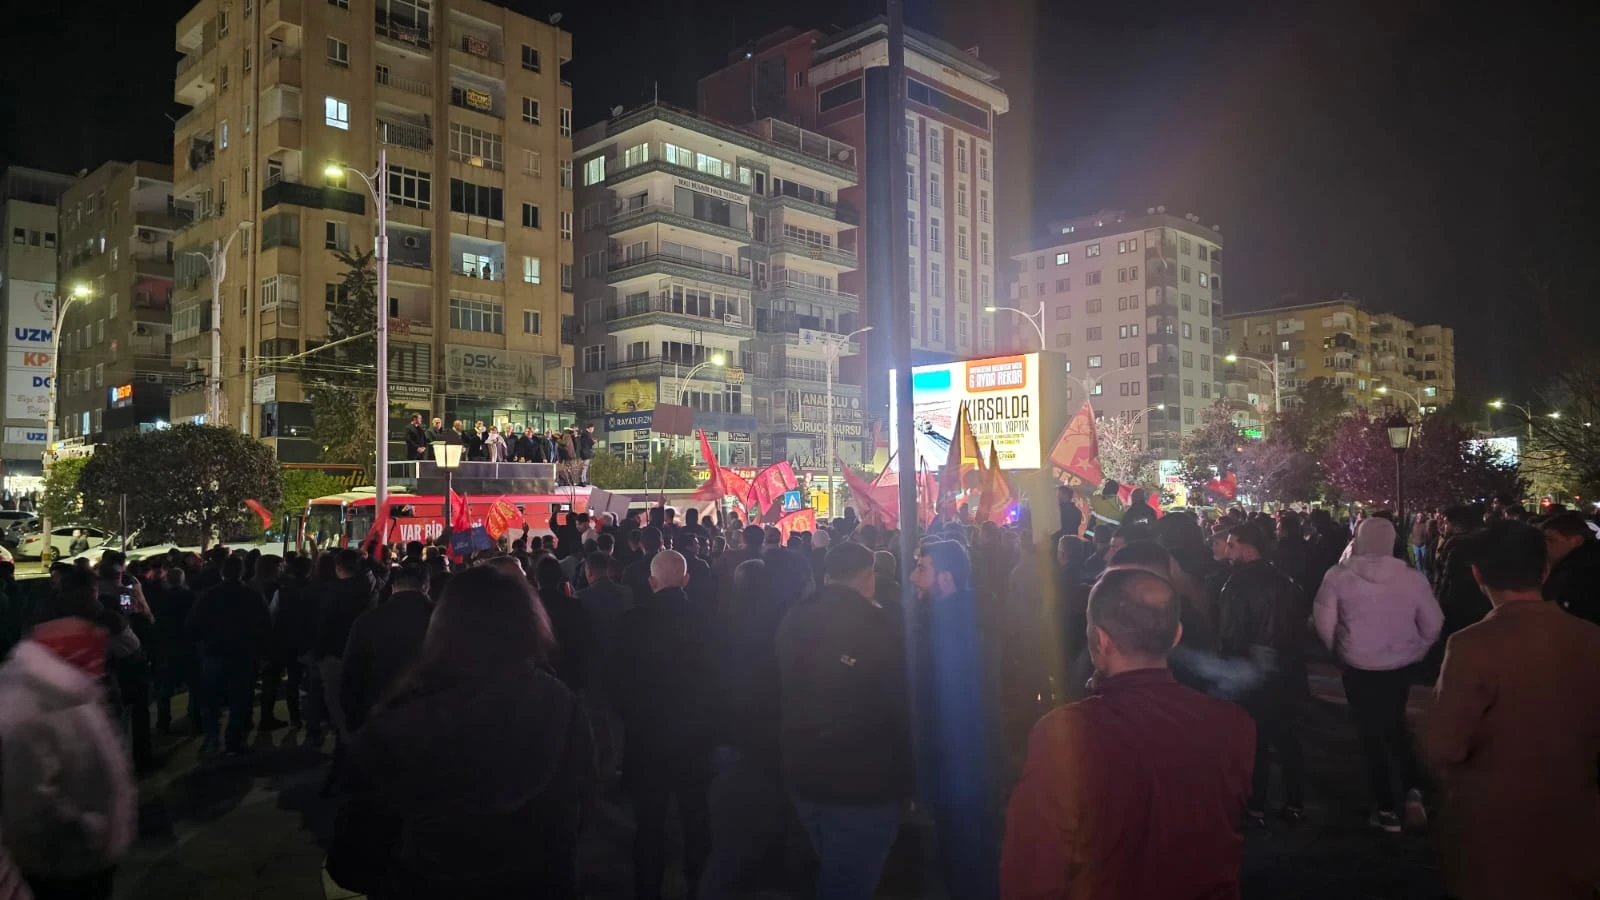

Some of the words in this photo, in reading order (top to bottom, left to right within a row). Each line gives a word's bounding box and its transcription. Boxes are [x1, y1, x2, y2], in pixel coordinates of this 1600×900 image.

[464, 354, 497, 369] DSK
[998, 369, 1022, 386] REKOR
[803, 393, 848, 409] ANADOLU
[965, 395, 1029, 421] KIRSALDA
[833, 423, 862, 436] KURSU
[992, 421, 1003, 433] YOL
[1005, 419, 1029, 432] YAPTIK
[400, 524, 421, 541] VAR
